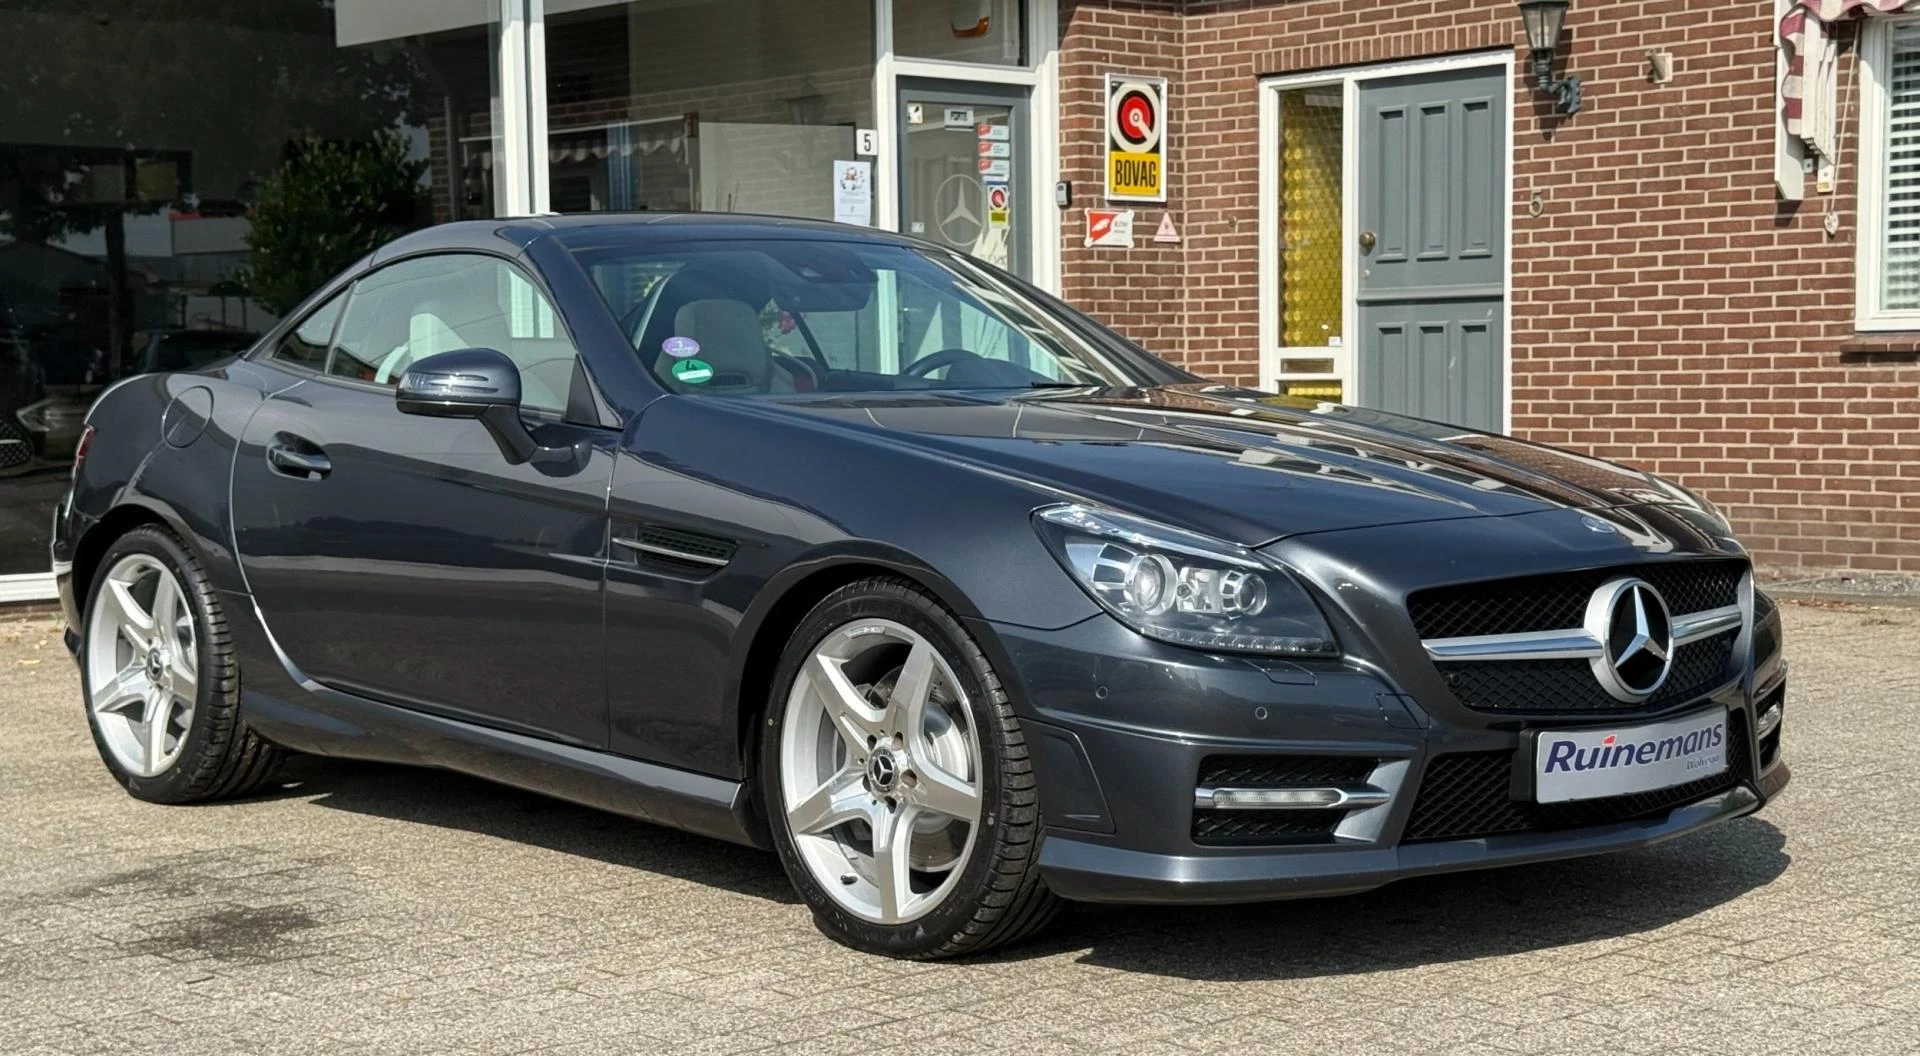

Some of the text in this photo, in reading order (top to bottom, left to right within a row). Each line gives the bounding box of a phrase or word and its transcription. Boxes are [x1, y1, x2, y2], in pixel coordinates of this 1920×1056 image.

[864, 133, 872, 152] 5
[1115, 159, 1156, 188] BOVAG
[1529, 188, 1544, 217] 5
[685, 360, 699, 371] 4
[1544, 723, 1723, 773] Ruinemans
